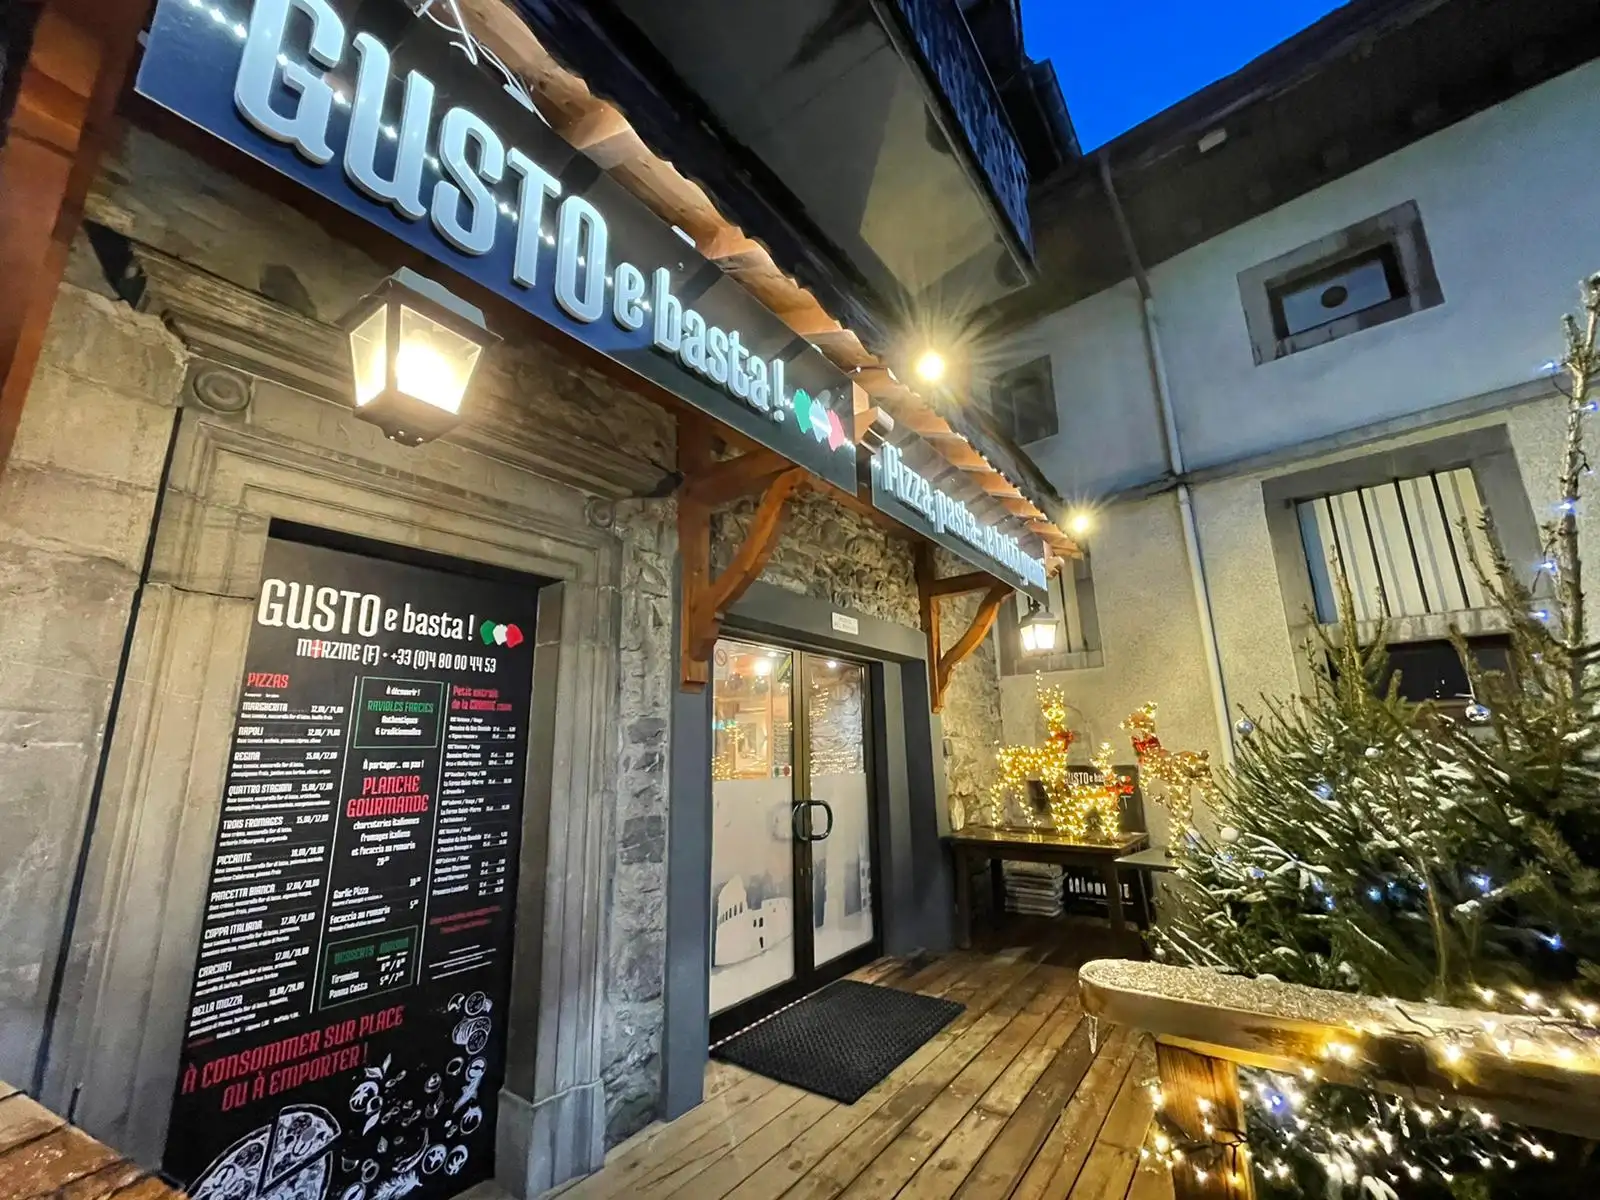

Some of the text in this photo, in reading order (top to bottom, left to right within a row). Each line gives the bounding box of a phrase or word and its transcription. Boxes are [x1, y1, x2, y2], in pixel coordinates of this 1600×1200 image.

[234, 0, 608, 323] GUSTO
[613, 261, 645, 330] e
[257, 578, 381, 637] GUSTO
[383, 607, 398, 632] e
[390, 648, 411, 666] +33
[413, 650, 436, 671] (0)4
[438, 651, 451, 669] 80
[454, 652, 467, 671] 00
[469, 654, 483, 671] 44
[484, 656, 497, 673] 53
[247, 672, 289, 688] PIZZAS
[238, 726, 264, 736] NAPOLI
[228, 784, 260, 796] QUATTRO
[362, 775, 420, 795] PLANCHE
[346, 794, 429, 817] GOURMANDE
[216, 852, 252, 866] PICCANTE
[210, 888, 248, 902] PANCETTA
[192, 1001, 215, 1017] BELLA
[181, 1062, 198, 1096] À
[201, 1035, 321, 1089] CONSOMMER
[323, 1019, 357, 1050] SUR
[358, 1005, 405, 1036] PLACE
[221, 1081, 248, 1112] OU
[252, 1071, 265, 1101] À
[269, 1045, 360, 1096] EMPORTER
